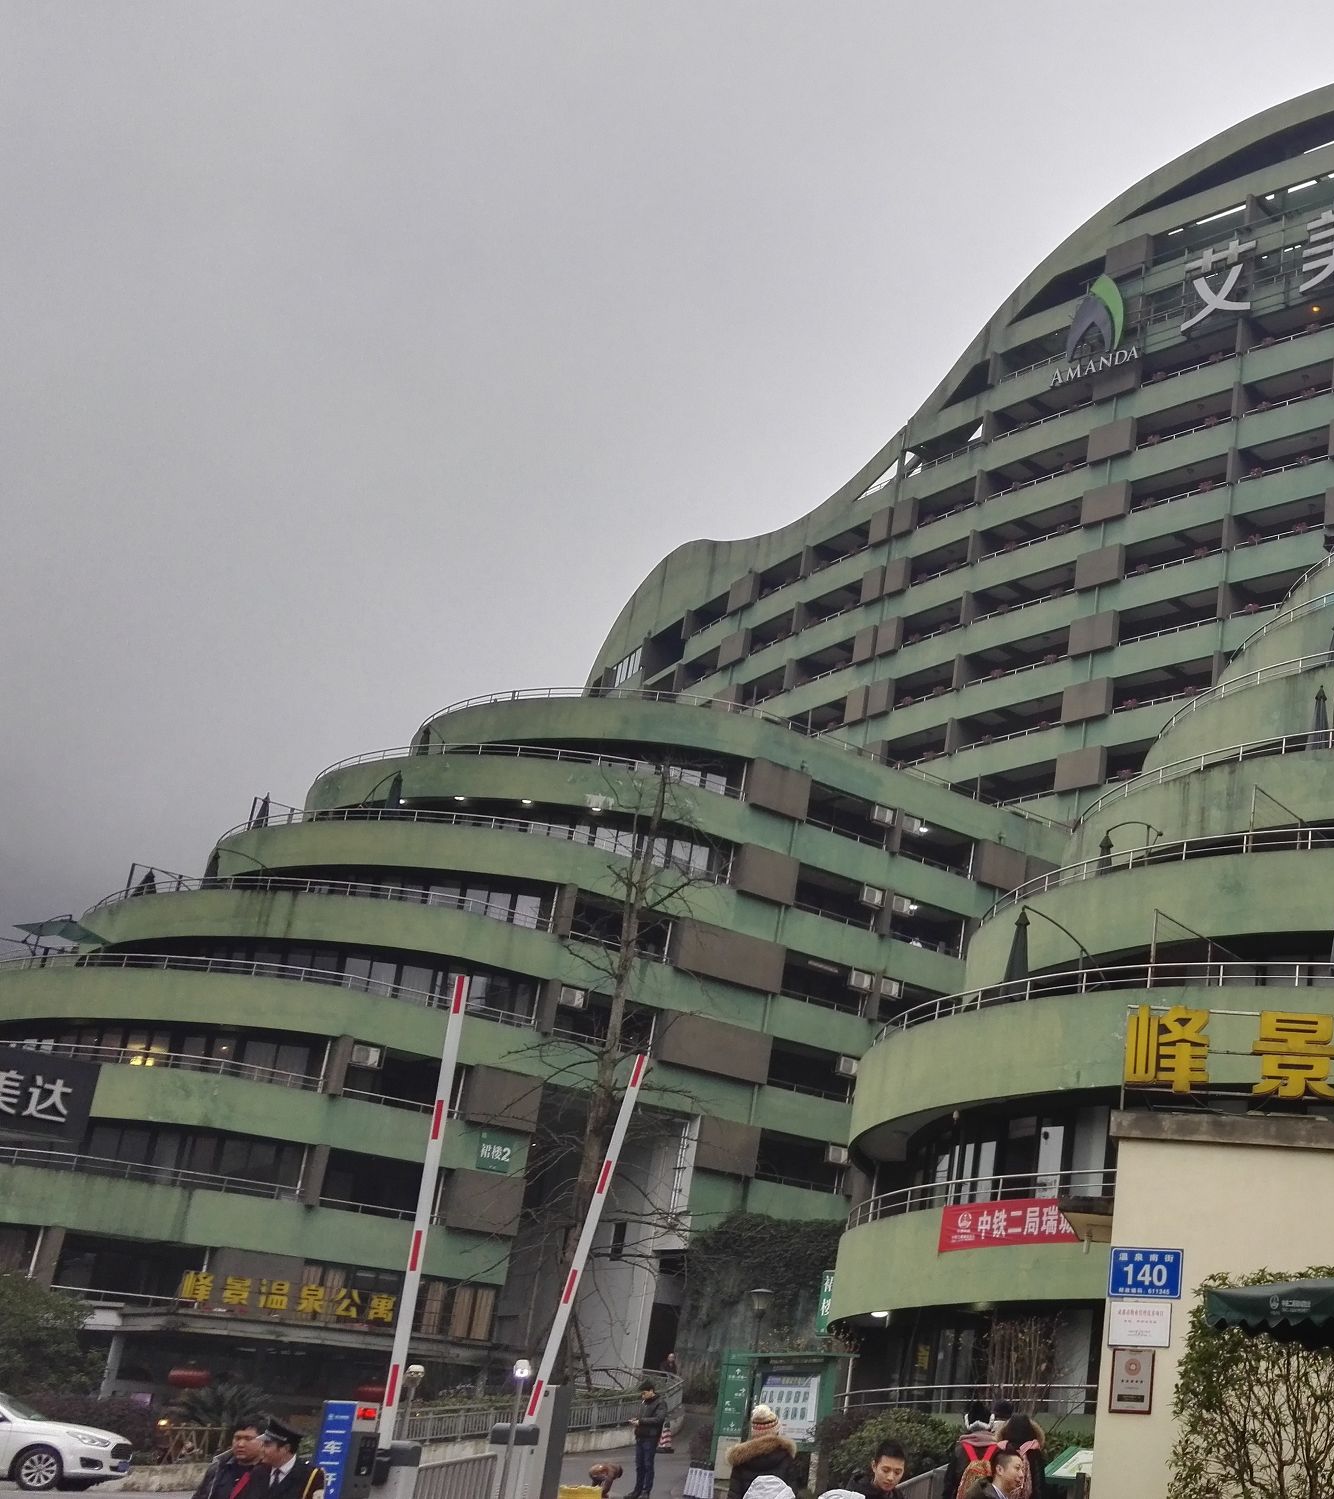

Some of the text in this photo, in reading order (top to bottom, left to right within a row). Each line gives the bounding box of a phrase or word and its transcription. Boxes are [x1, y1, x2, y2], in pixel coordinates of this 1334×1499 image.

[1050, 345, 1139, 387] AMANDA
[1118, 1252, 1175, 1263] 温泉南街
[1123, 1263, 1168, 1287] 140
[182, 1270, 397, 1322] 峰景温泉公寓
